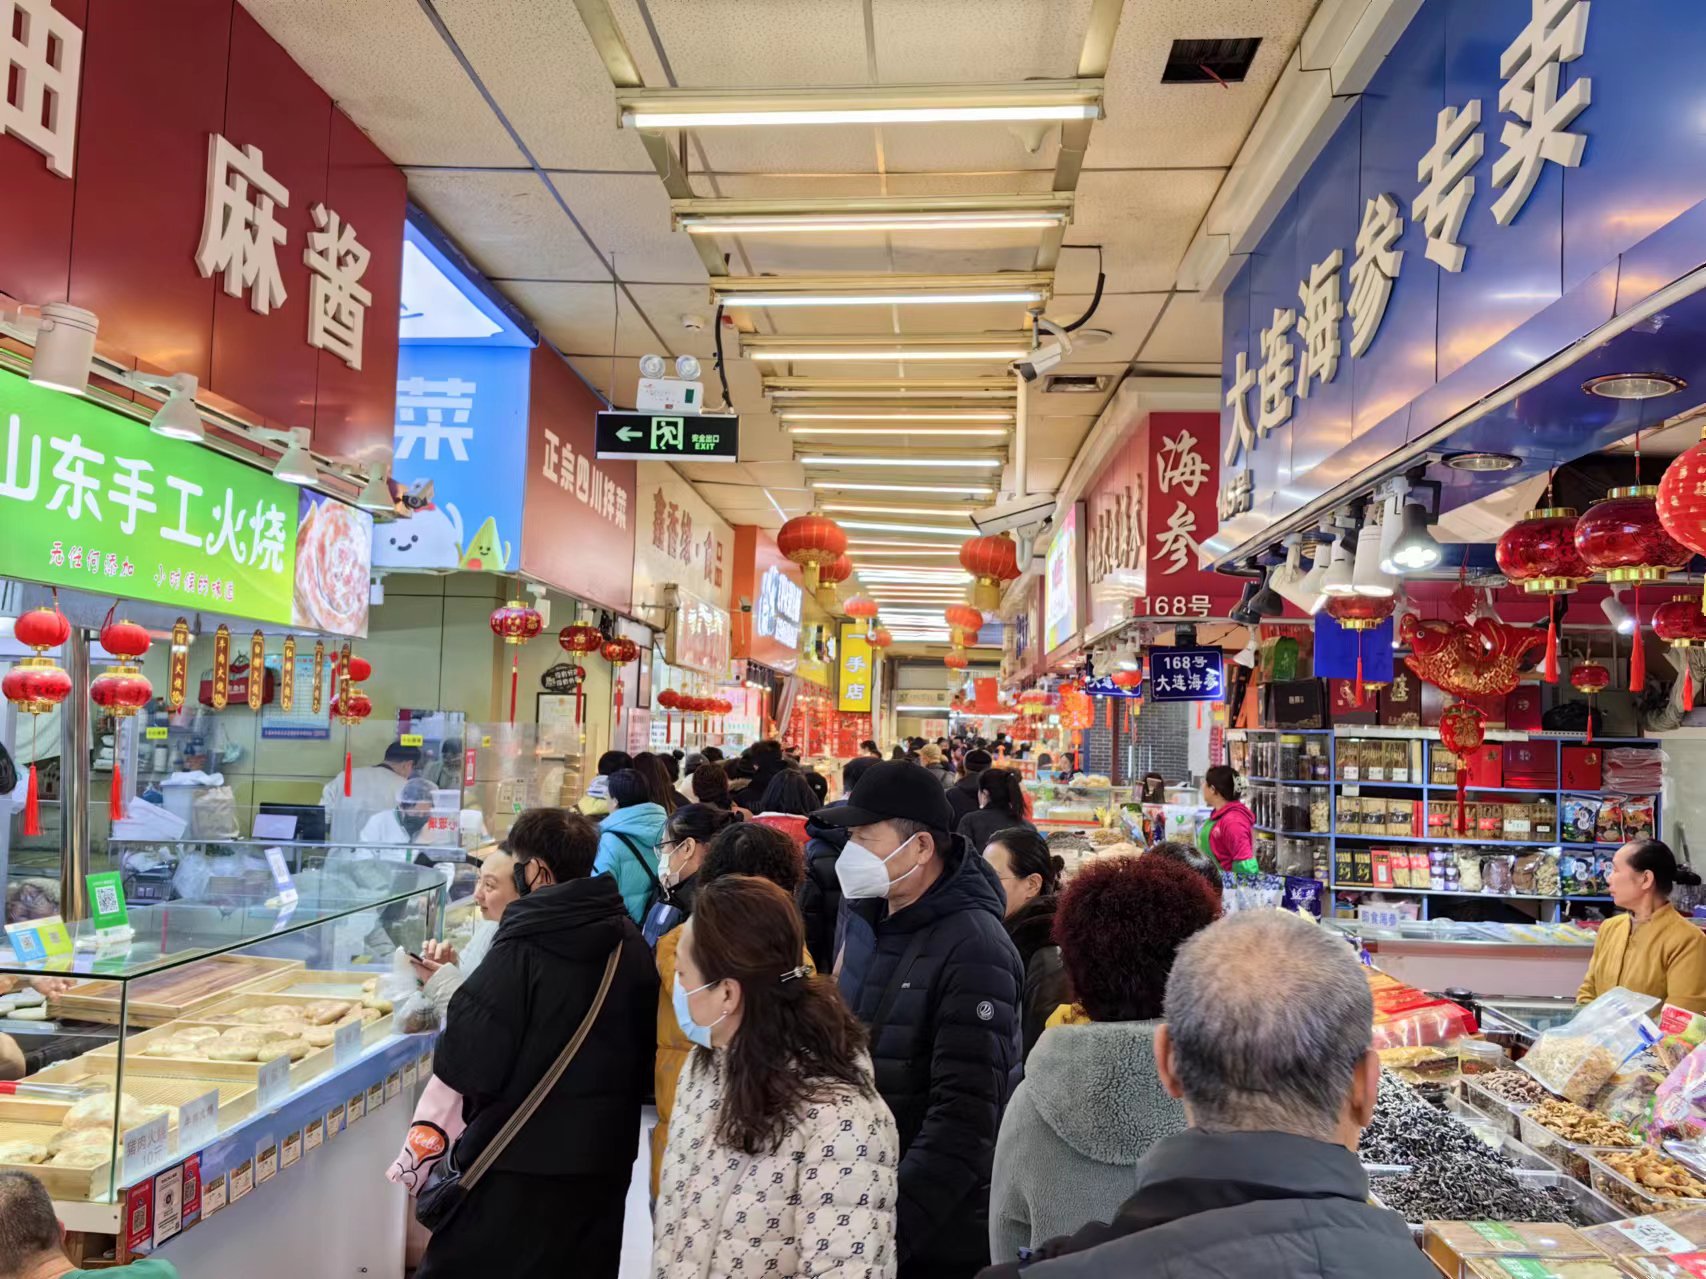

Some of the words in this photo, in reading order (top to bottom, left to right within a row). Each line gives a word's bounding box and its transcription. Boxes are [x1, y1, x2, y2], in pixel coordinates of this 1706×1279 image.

[195, 132, 372, 371] 麻酱
[393, 377, 477, 461] 菜
[691, 434, 720, 443] 安全出口
[0, 414, 287, 573] 山东手工火烧
[1152, 429, 1211, 575] 海参
[49, 541, 135, 577] 无任何添加
[1142, 595, 1212, 618] 168号
[1164, 656, 1208, 669] 168号
[1156, 672, 1219, 691] 大连海参
